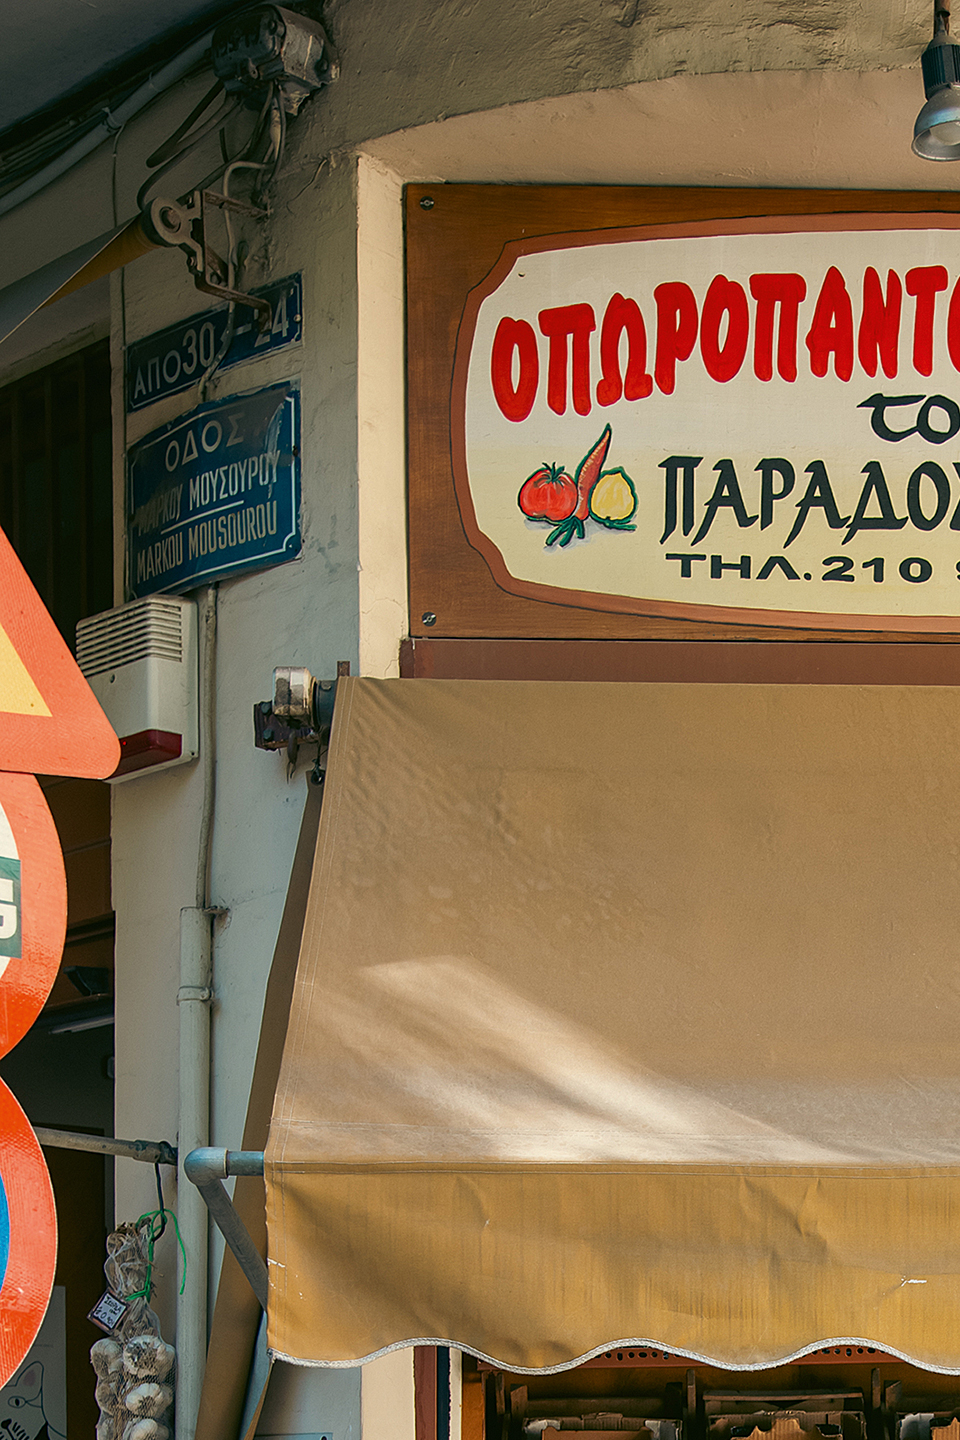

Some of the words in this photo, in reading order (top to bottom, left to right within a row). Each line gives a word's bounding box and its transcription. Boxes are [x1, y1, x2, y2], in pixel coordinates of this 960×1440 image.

[165, 412, 245, 473] ΟΔΟΣ
[189, 450, 280, 511] ΜΟΥΣΟΥΡΟΥ
[137, 531, 183, 584] MARKOU
[188, 501, 277, 560] MOUSOUROU
